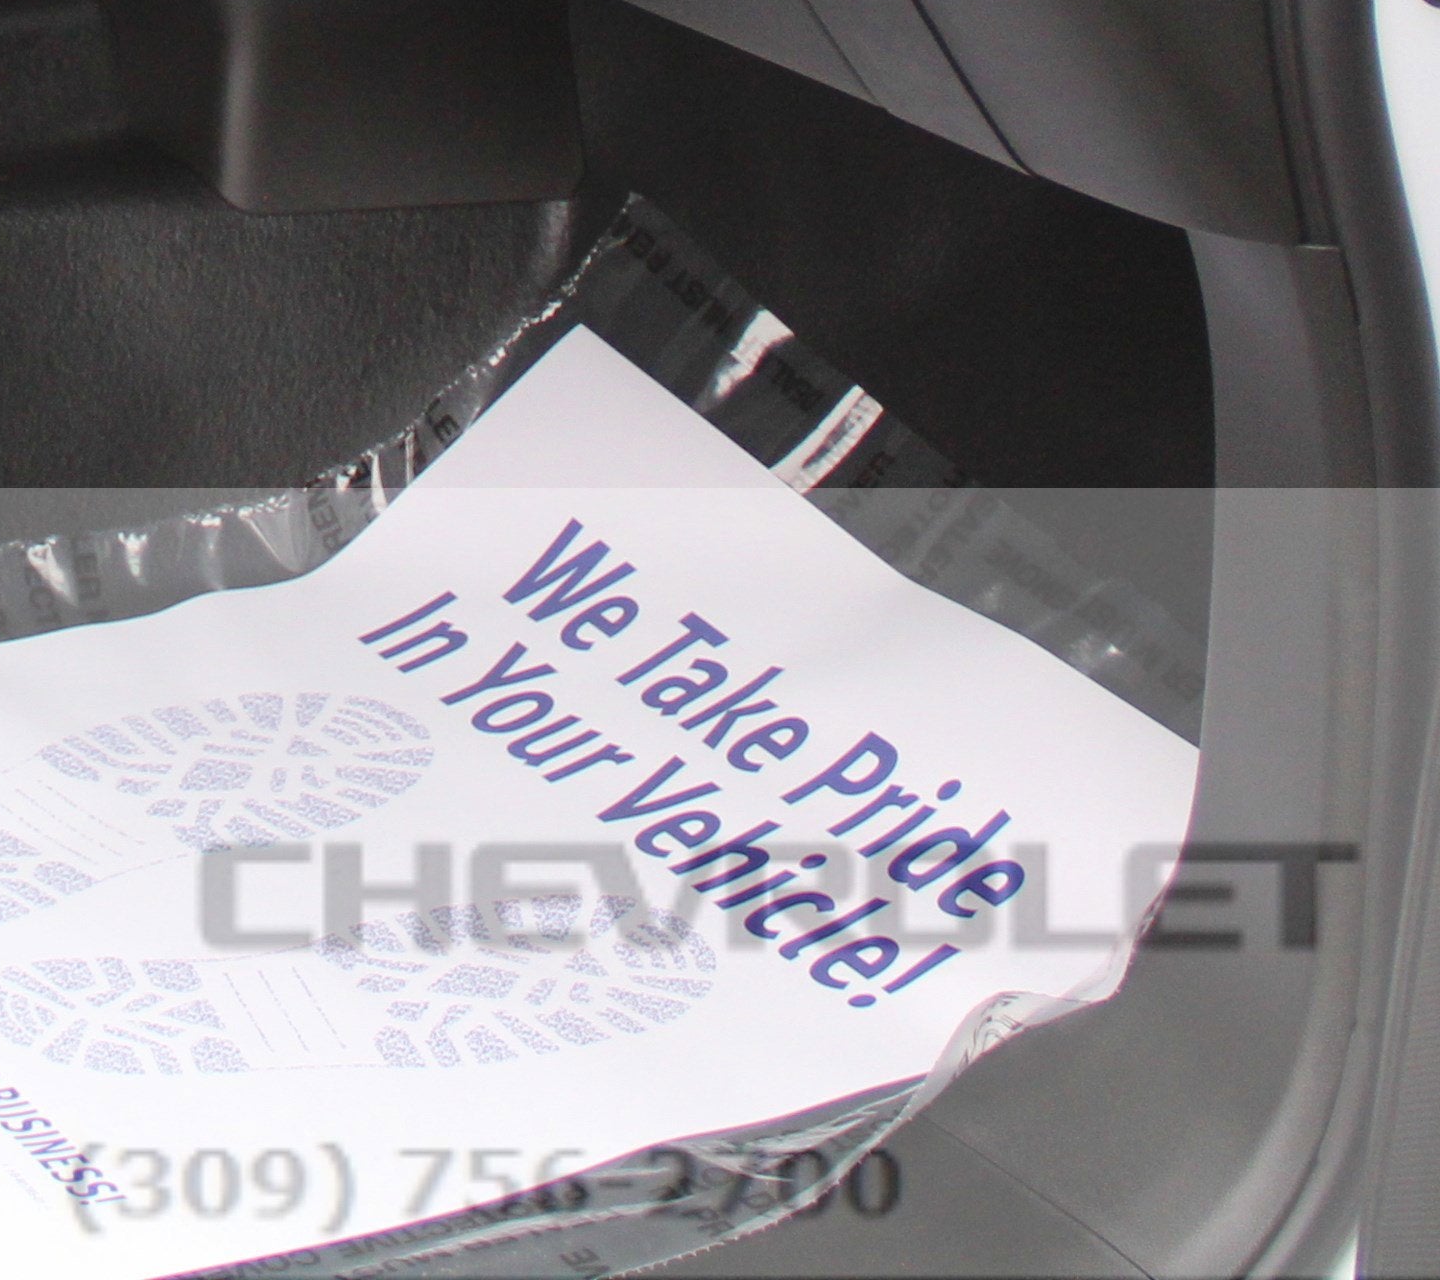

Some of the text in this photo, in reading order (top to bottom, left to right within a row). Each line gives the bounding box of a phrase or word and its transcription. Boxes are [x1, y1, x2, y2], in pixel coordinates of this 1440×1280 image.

[357, 590, 961, 1008] In Your Vehicle!
[502, 517, 1026, 919] We Take Pride
